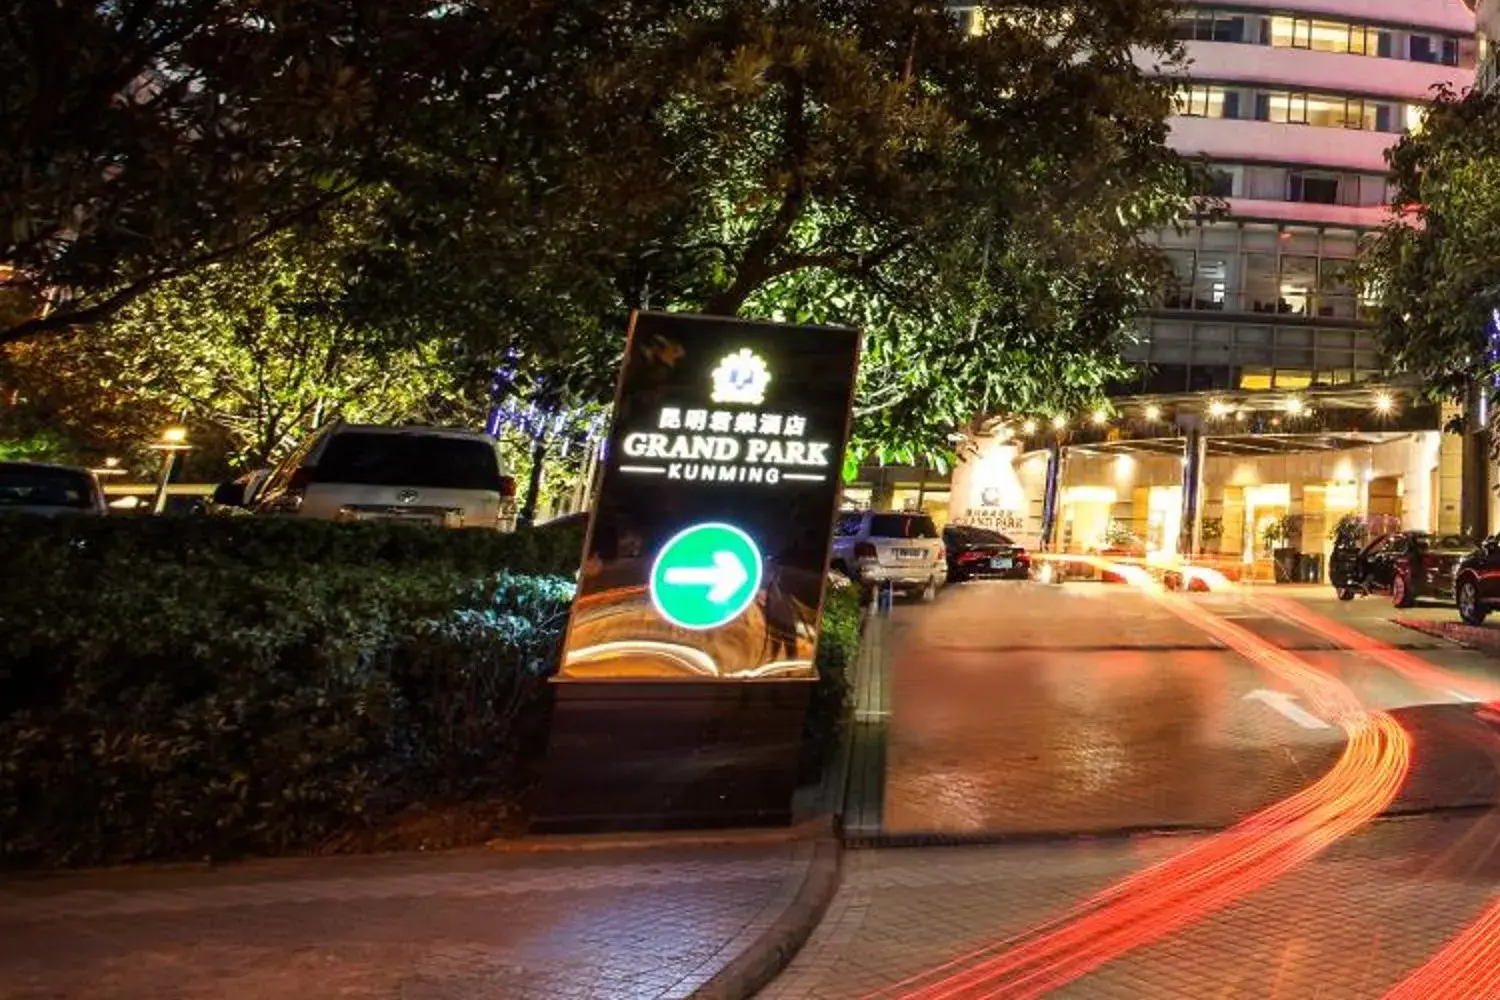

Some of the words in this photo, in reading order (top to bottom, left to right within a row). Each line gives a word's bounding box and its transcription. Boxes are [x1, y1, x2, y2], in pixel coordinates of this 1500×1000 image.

[623, 432, 740, 461] GRAND
[744, 438, 830, 466] PARK
[667, 462, 780, 485] KUNMING
